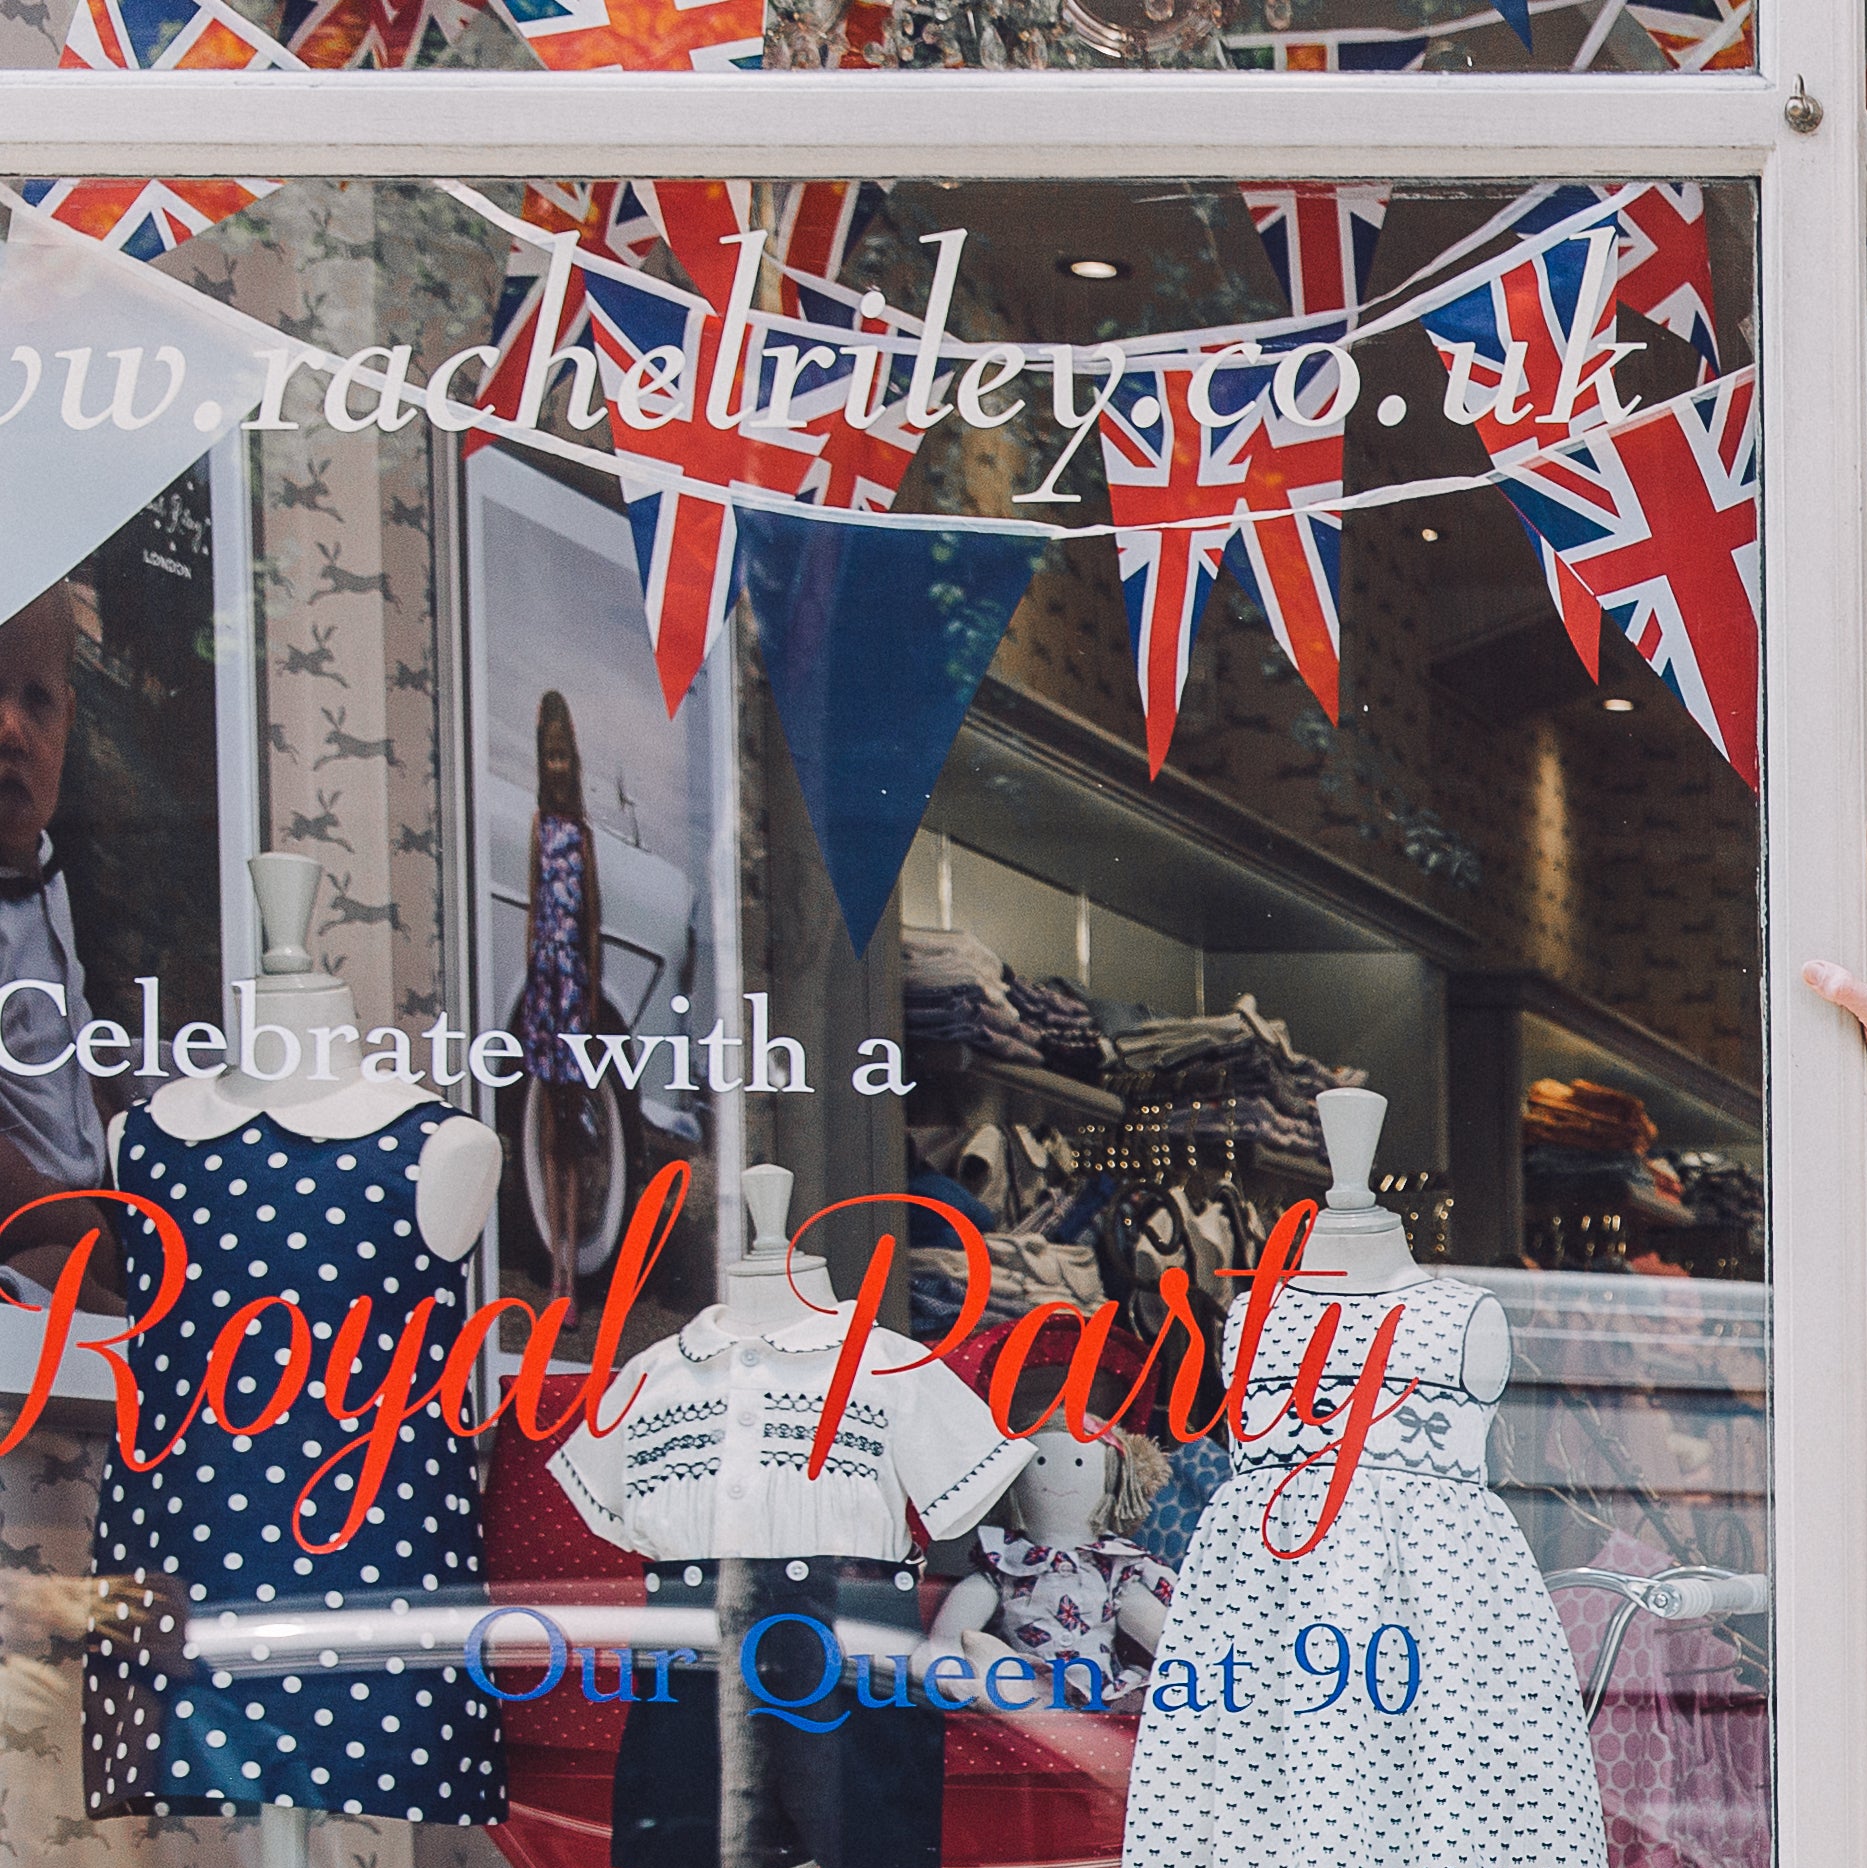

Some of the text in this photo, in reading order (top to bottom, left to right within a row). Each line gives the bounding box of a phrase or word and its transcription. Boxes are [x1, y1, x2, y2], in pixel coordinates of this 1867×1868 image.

[0, 976, 917, 1097] Celebrate with a
[0, 1157, 1424, 1561] Royal Party
[464, 1606, 1423, 1735] Our Queen at 90
